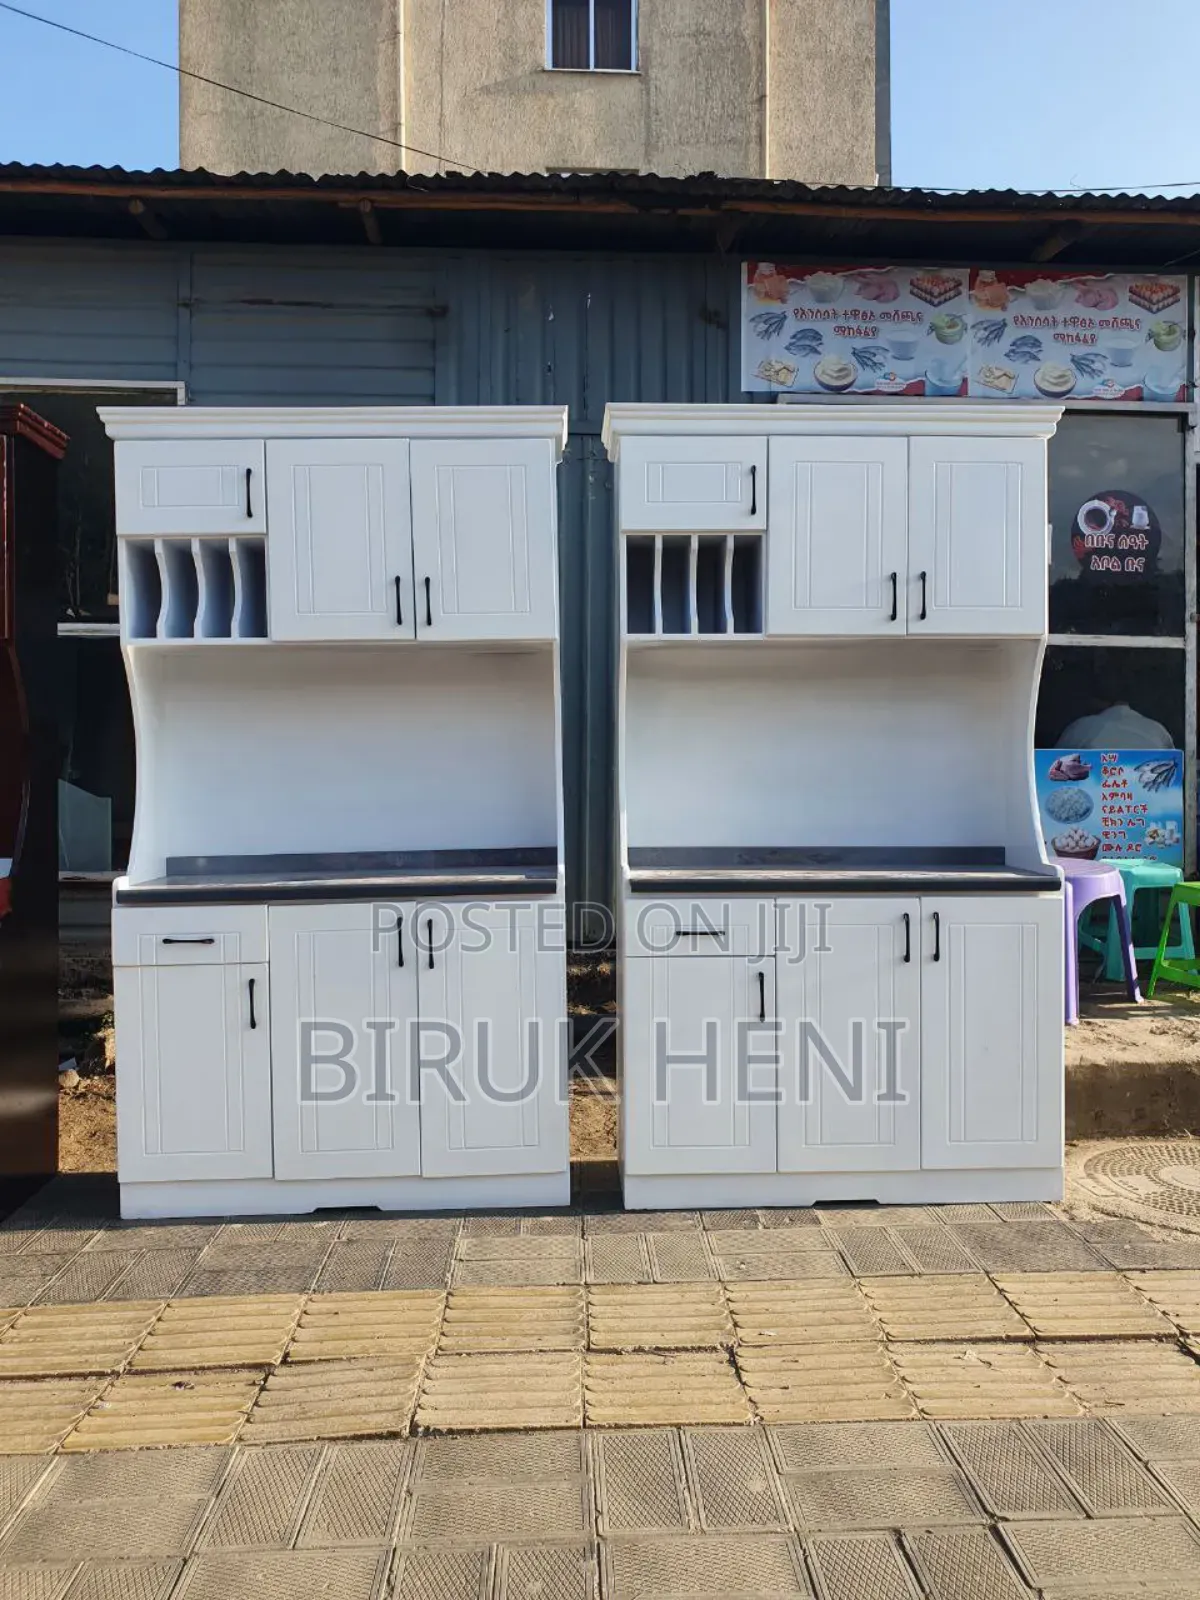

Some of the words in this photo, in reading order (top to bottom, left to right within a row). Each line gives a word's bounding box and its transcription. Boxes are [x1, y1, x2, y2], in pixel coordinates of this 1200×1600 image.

[1084, 533, 1116, 549] በቡና
[1118, 533, 1149, 550] ሰዓት
[1090, 555, 1121, 572] አቦል
[1124, 557, 1146, 572] ቡና
